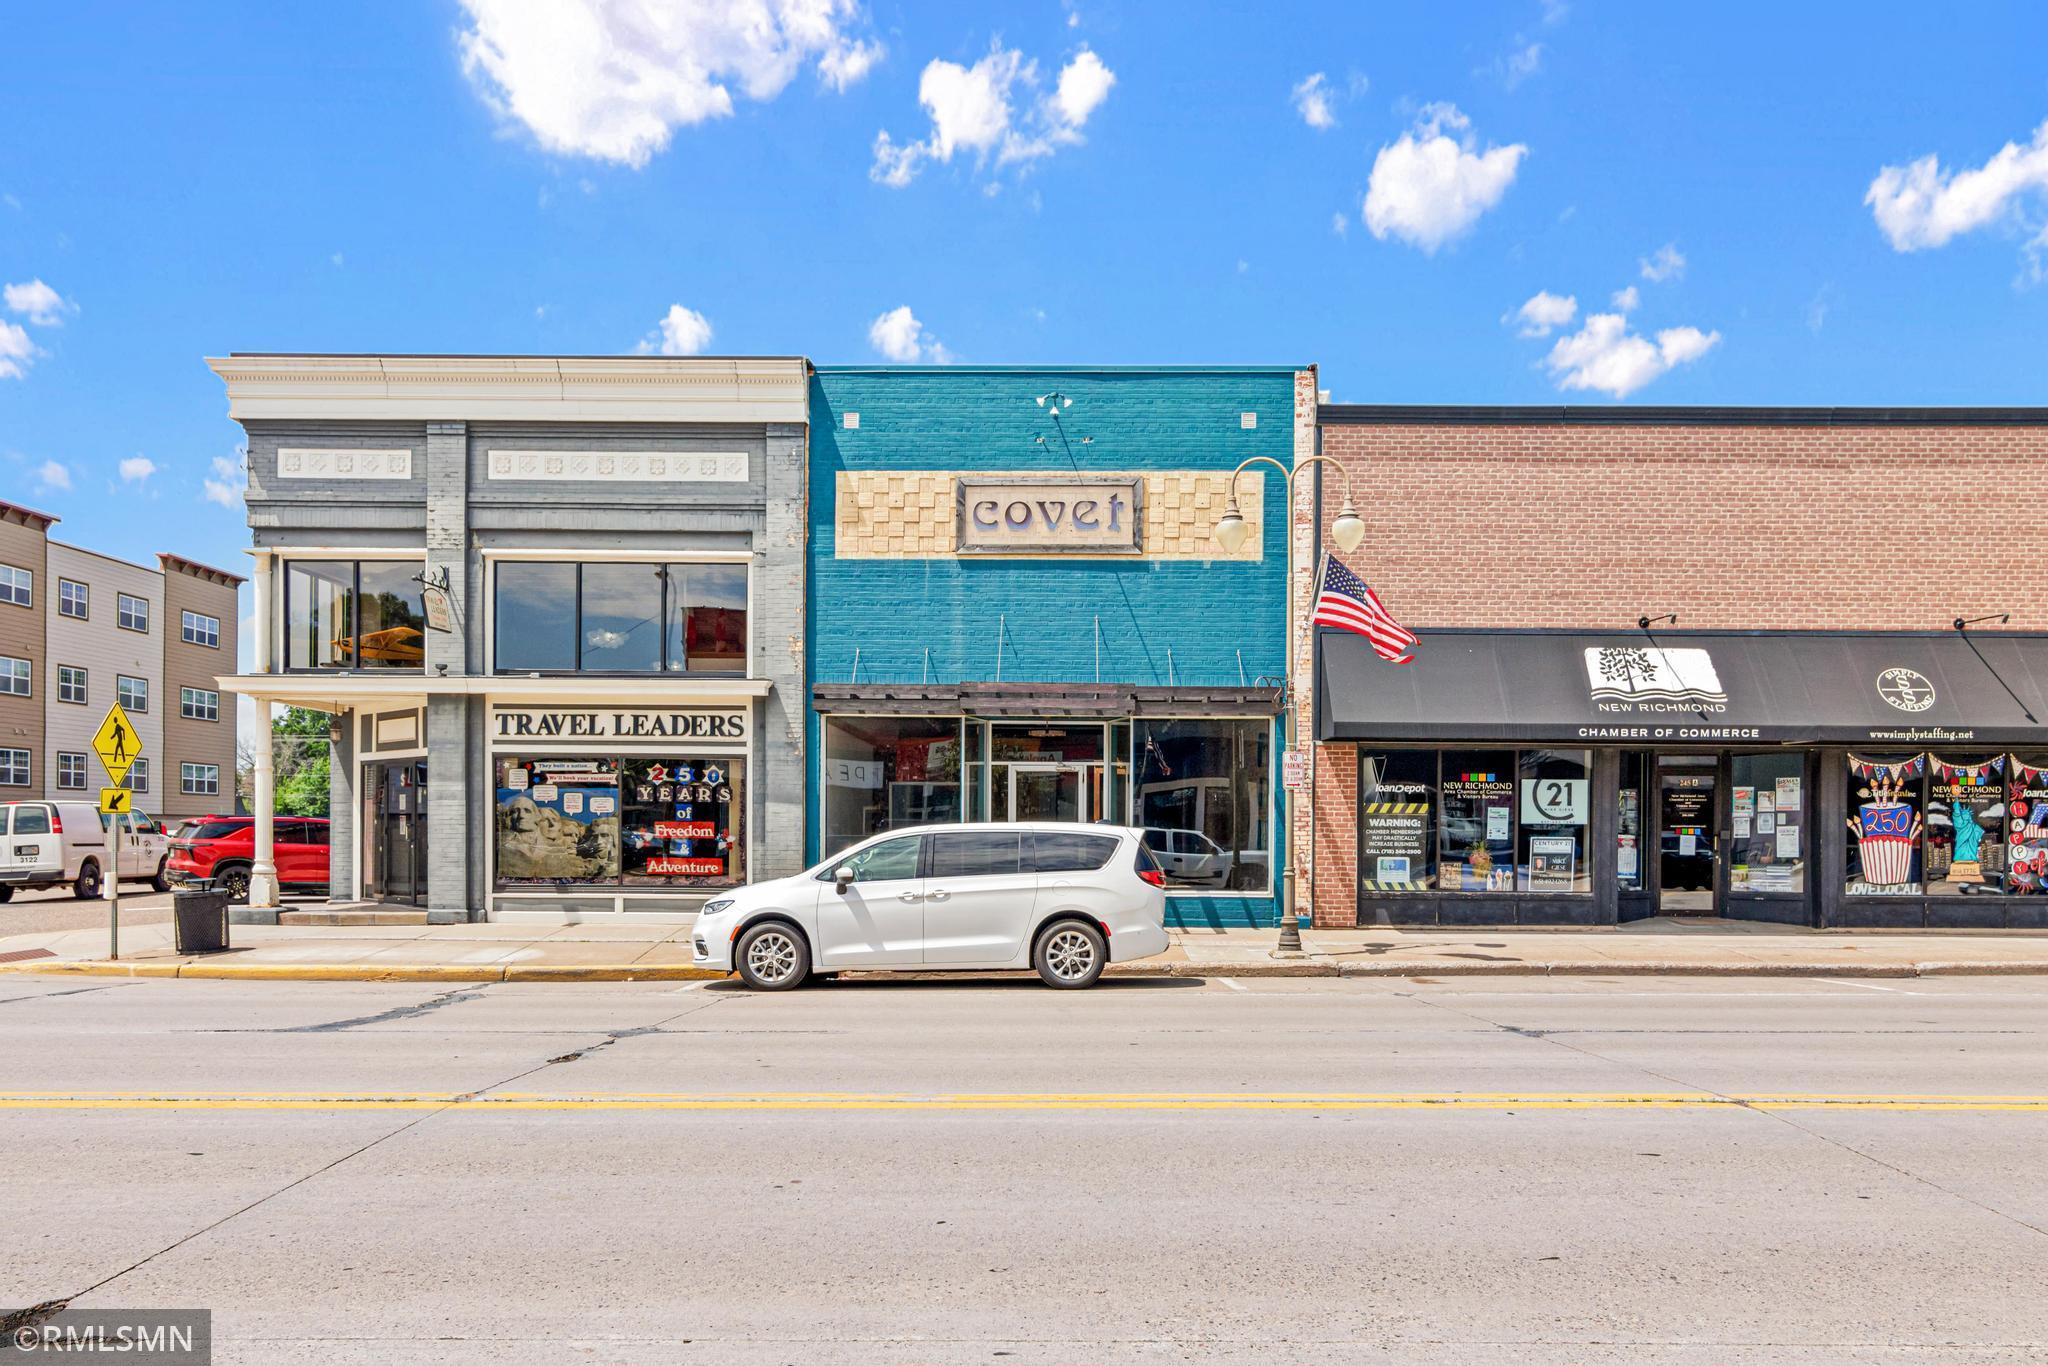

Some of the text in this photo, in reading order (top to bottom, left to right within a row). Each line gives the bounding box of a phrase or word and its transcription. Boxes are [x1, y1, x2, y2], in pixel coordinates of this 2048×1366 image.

[972, 492, 1124, 532] covet
[1884, 669, 1919, 680] SIMPLY
[1599, 703, 1726, 713] NEW RICHMOND
[1888, 695, 1932, 711] STAFFING
[495, 714, 744, 737] TRAVEL LEADERS
[1578, 728, 1760, 738] CHAMBER OF COMMERCE
[1375, 784, 1426, 794] loanDepot
[1465, 782, 1513, 790] RICHMOND
[640, 787, 731, 800] YEARS
[1546, 782, 1573, 806] 21
[676, 808, 692, 819] of
[1369, 819, 1421, 827] WARNING:
[1866, 811, 1909, 833] 250
[655, 825, 714, 837] Freedom
[681, 844, 690, 853] &
[647, 861, 719, 873] Adventure
